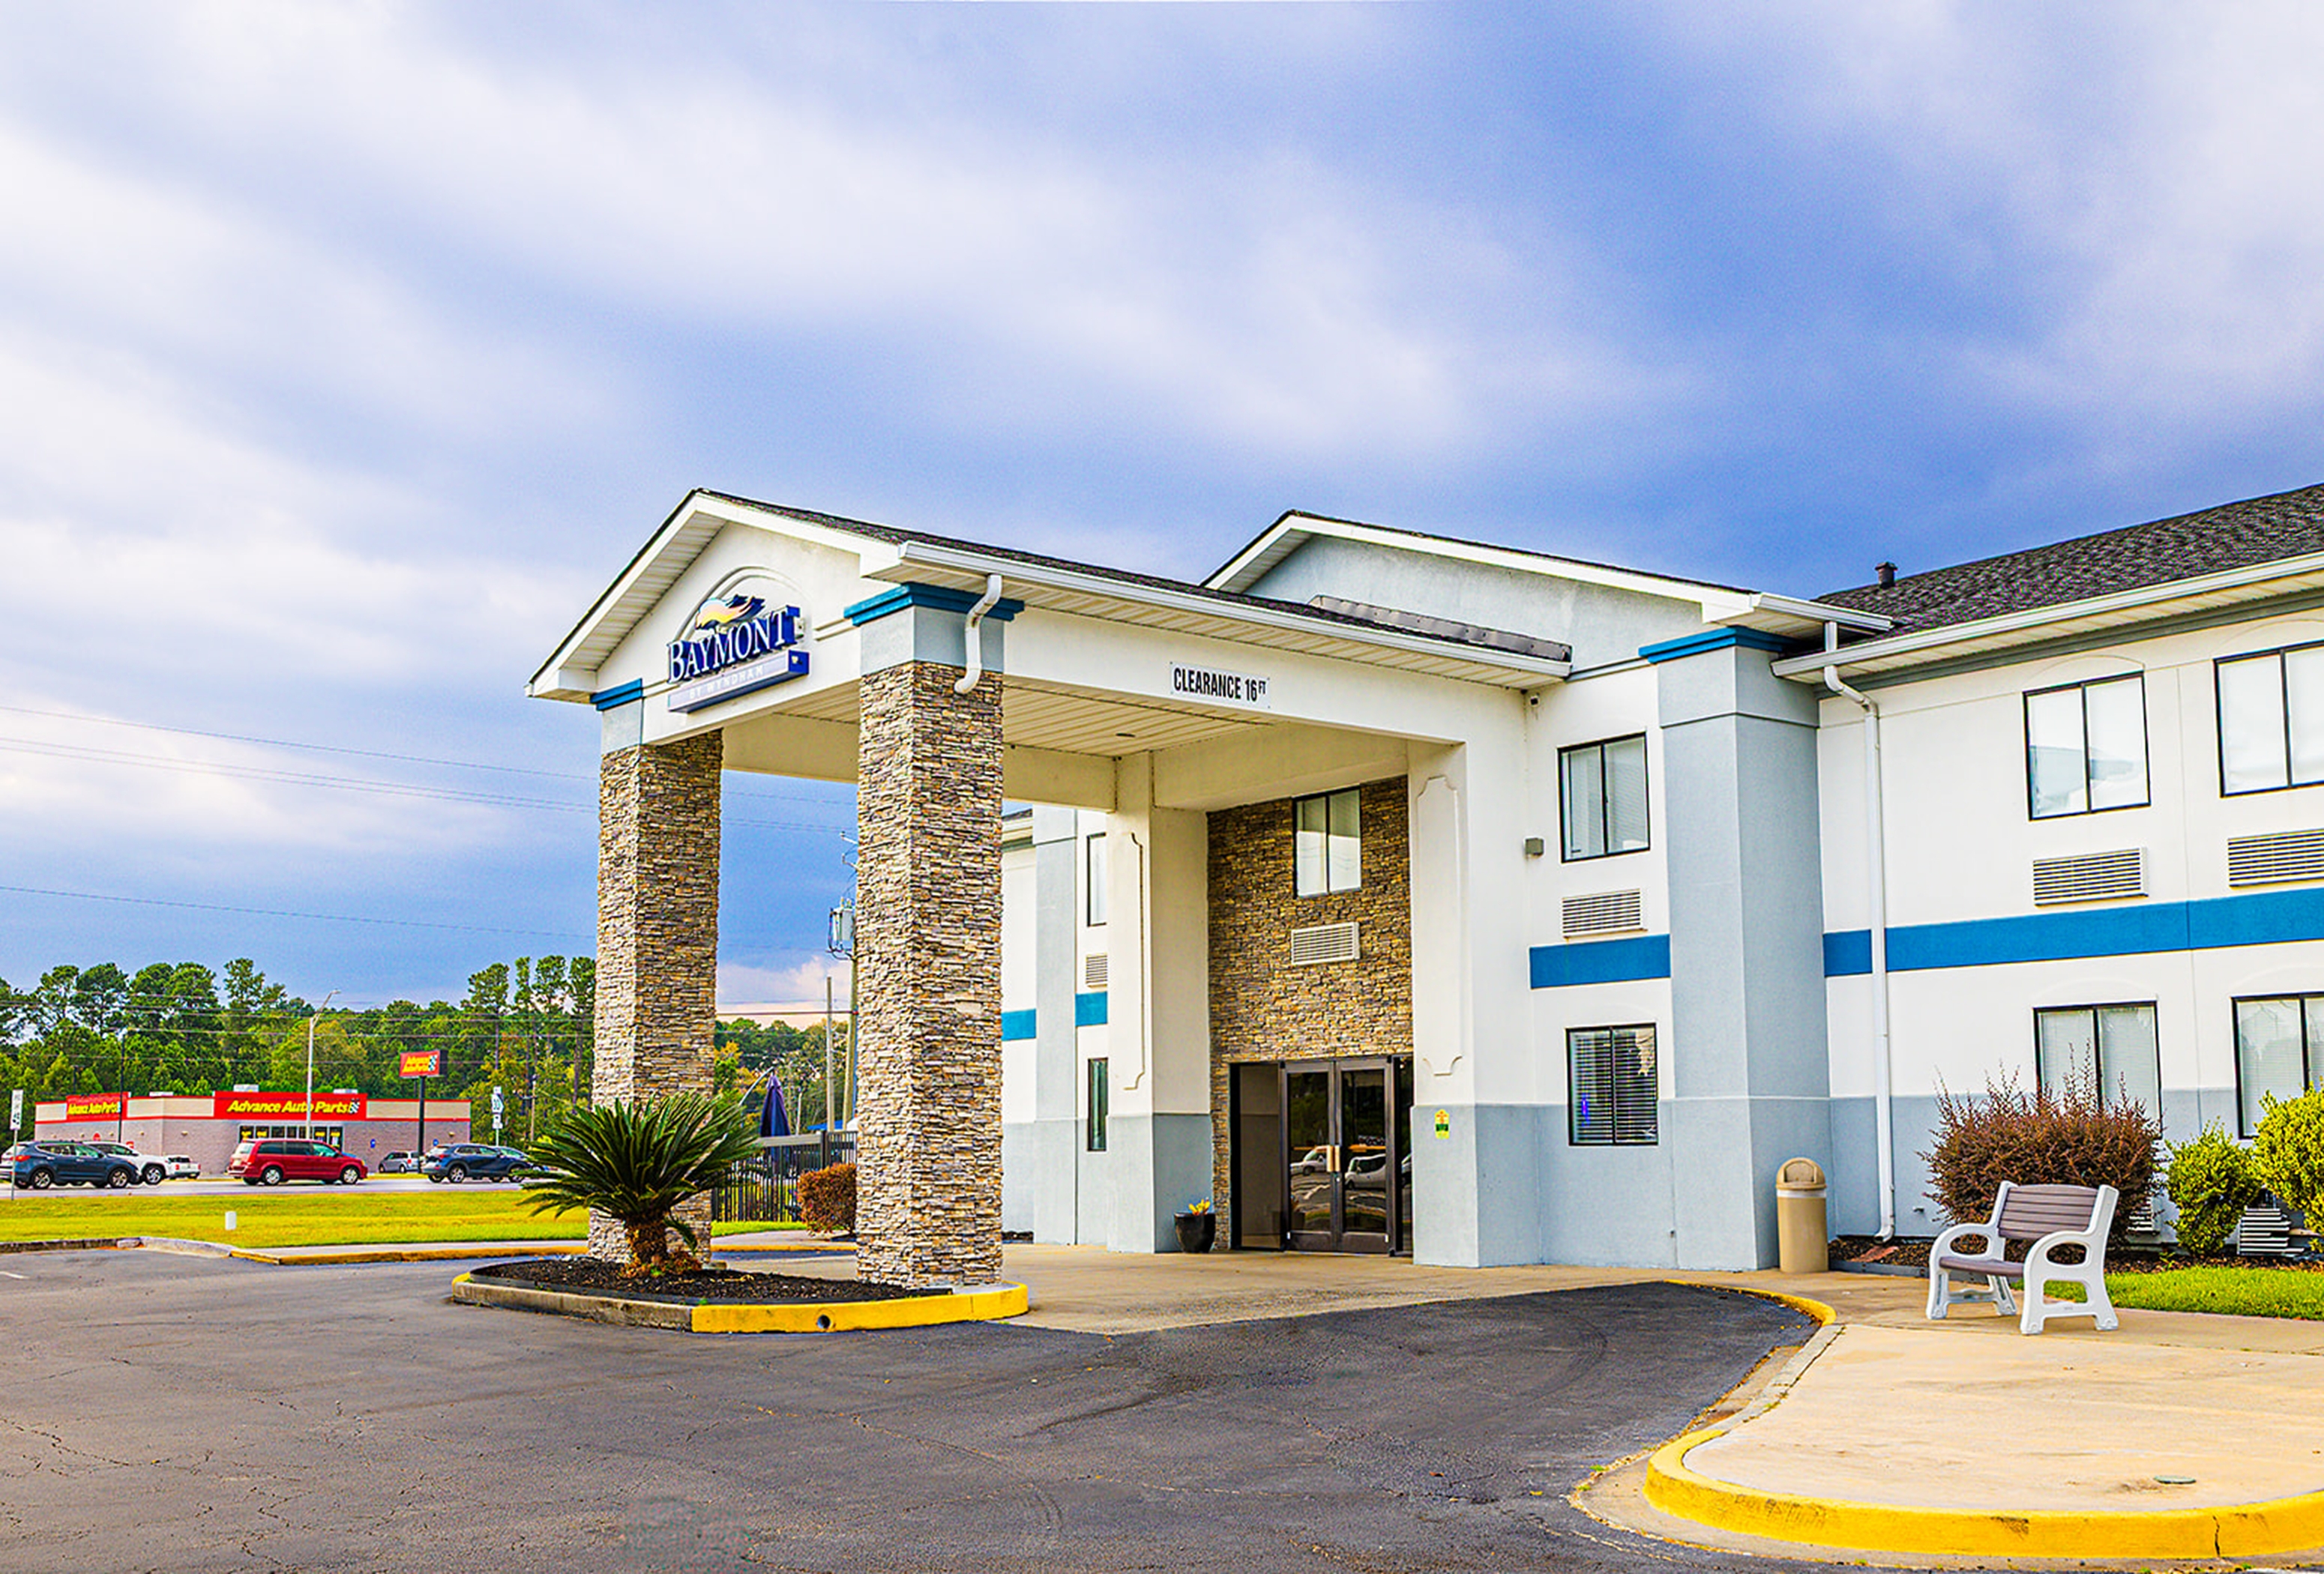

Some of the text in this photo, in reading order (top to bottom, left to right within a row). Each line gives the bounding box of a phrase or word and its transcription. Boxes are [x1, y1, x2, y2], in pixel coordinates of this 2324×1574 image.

[668, 606, 799, 684] BAYMONT
[1174, 667, 1241, 699] CLEARANCE
[226, 1100, 281, 1113] Advance
[314, 1101, 347, 1113] Parts
